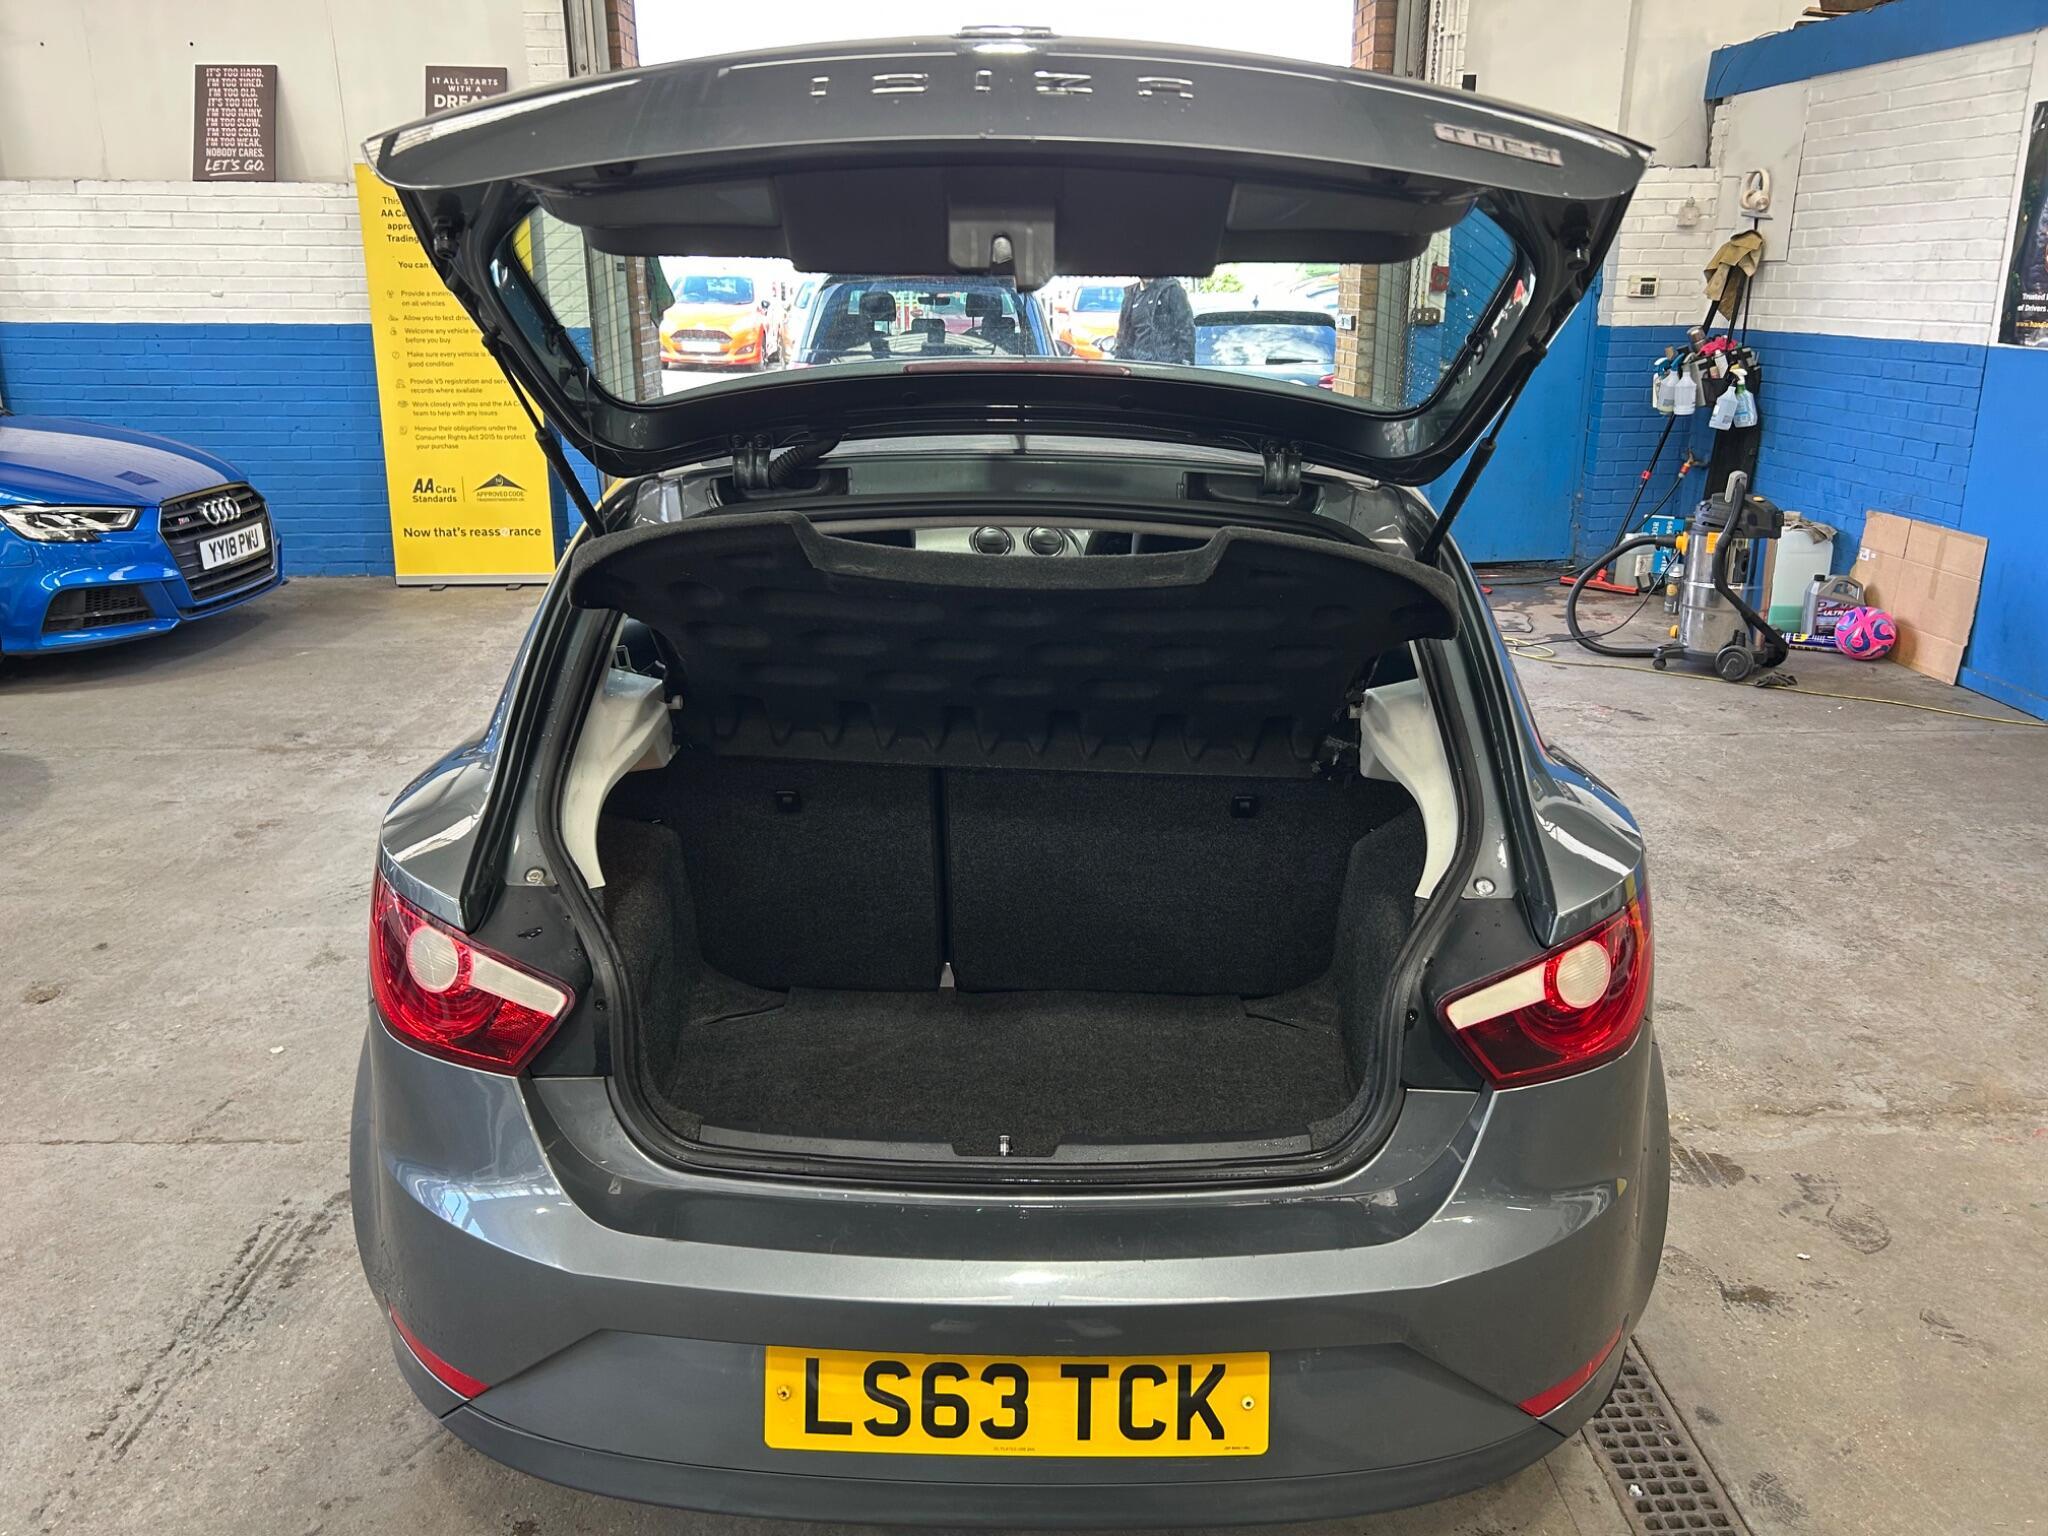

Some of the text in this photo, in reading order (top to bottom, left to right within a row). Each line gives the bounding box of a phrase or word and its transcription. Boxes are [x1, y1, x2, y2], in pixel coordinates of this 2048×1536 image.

[206, 68, 264, 78] IT'S TOO HARD.
[207, 78, 264, 87] I'M TOO TIRED.
[432, 76, 440, 84] IT
[464, 78, 498, 86] STARTS
[810, 70, 1193, 98] IBIZA
[209, 88, 258, 97] I'M TOO OLD.
[208, 98, 259, 107] IT'S TOO HOT.
[434, 94, 488, 108] DREA
[206, 108, 263, 117] I'M TOO RAINY.
[206, 118, 261, 127] I'M TOO SLOW.
[207, 128, 261, 137] I'M TOO COLD.
[206, 137, 262, 147] I'M TOO WEAK.
[206, 148, 264, 157] NOBODY CARES.
[205, 158, 265, 171] LET'S GO.
[382, 196, 400, 205] This
[381, 209, 407, 217] AA Ca
[387, 223, 413, 231] appro
[387, 234, 419, 244] Trading
[398, 261, 413, 269] You
[444, 378, 480, 386] registration
[413, 478, 456, 494] AA Cars
[412, 495, 458, 503] Standards
[403, 527, 541, 537] Now that's reassrance
[208, 536, 237, 562] YY18
[805, 1358, 1226, 1440] LS63 TCK
